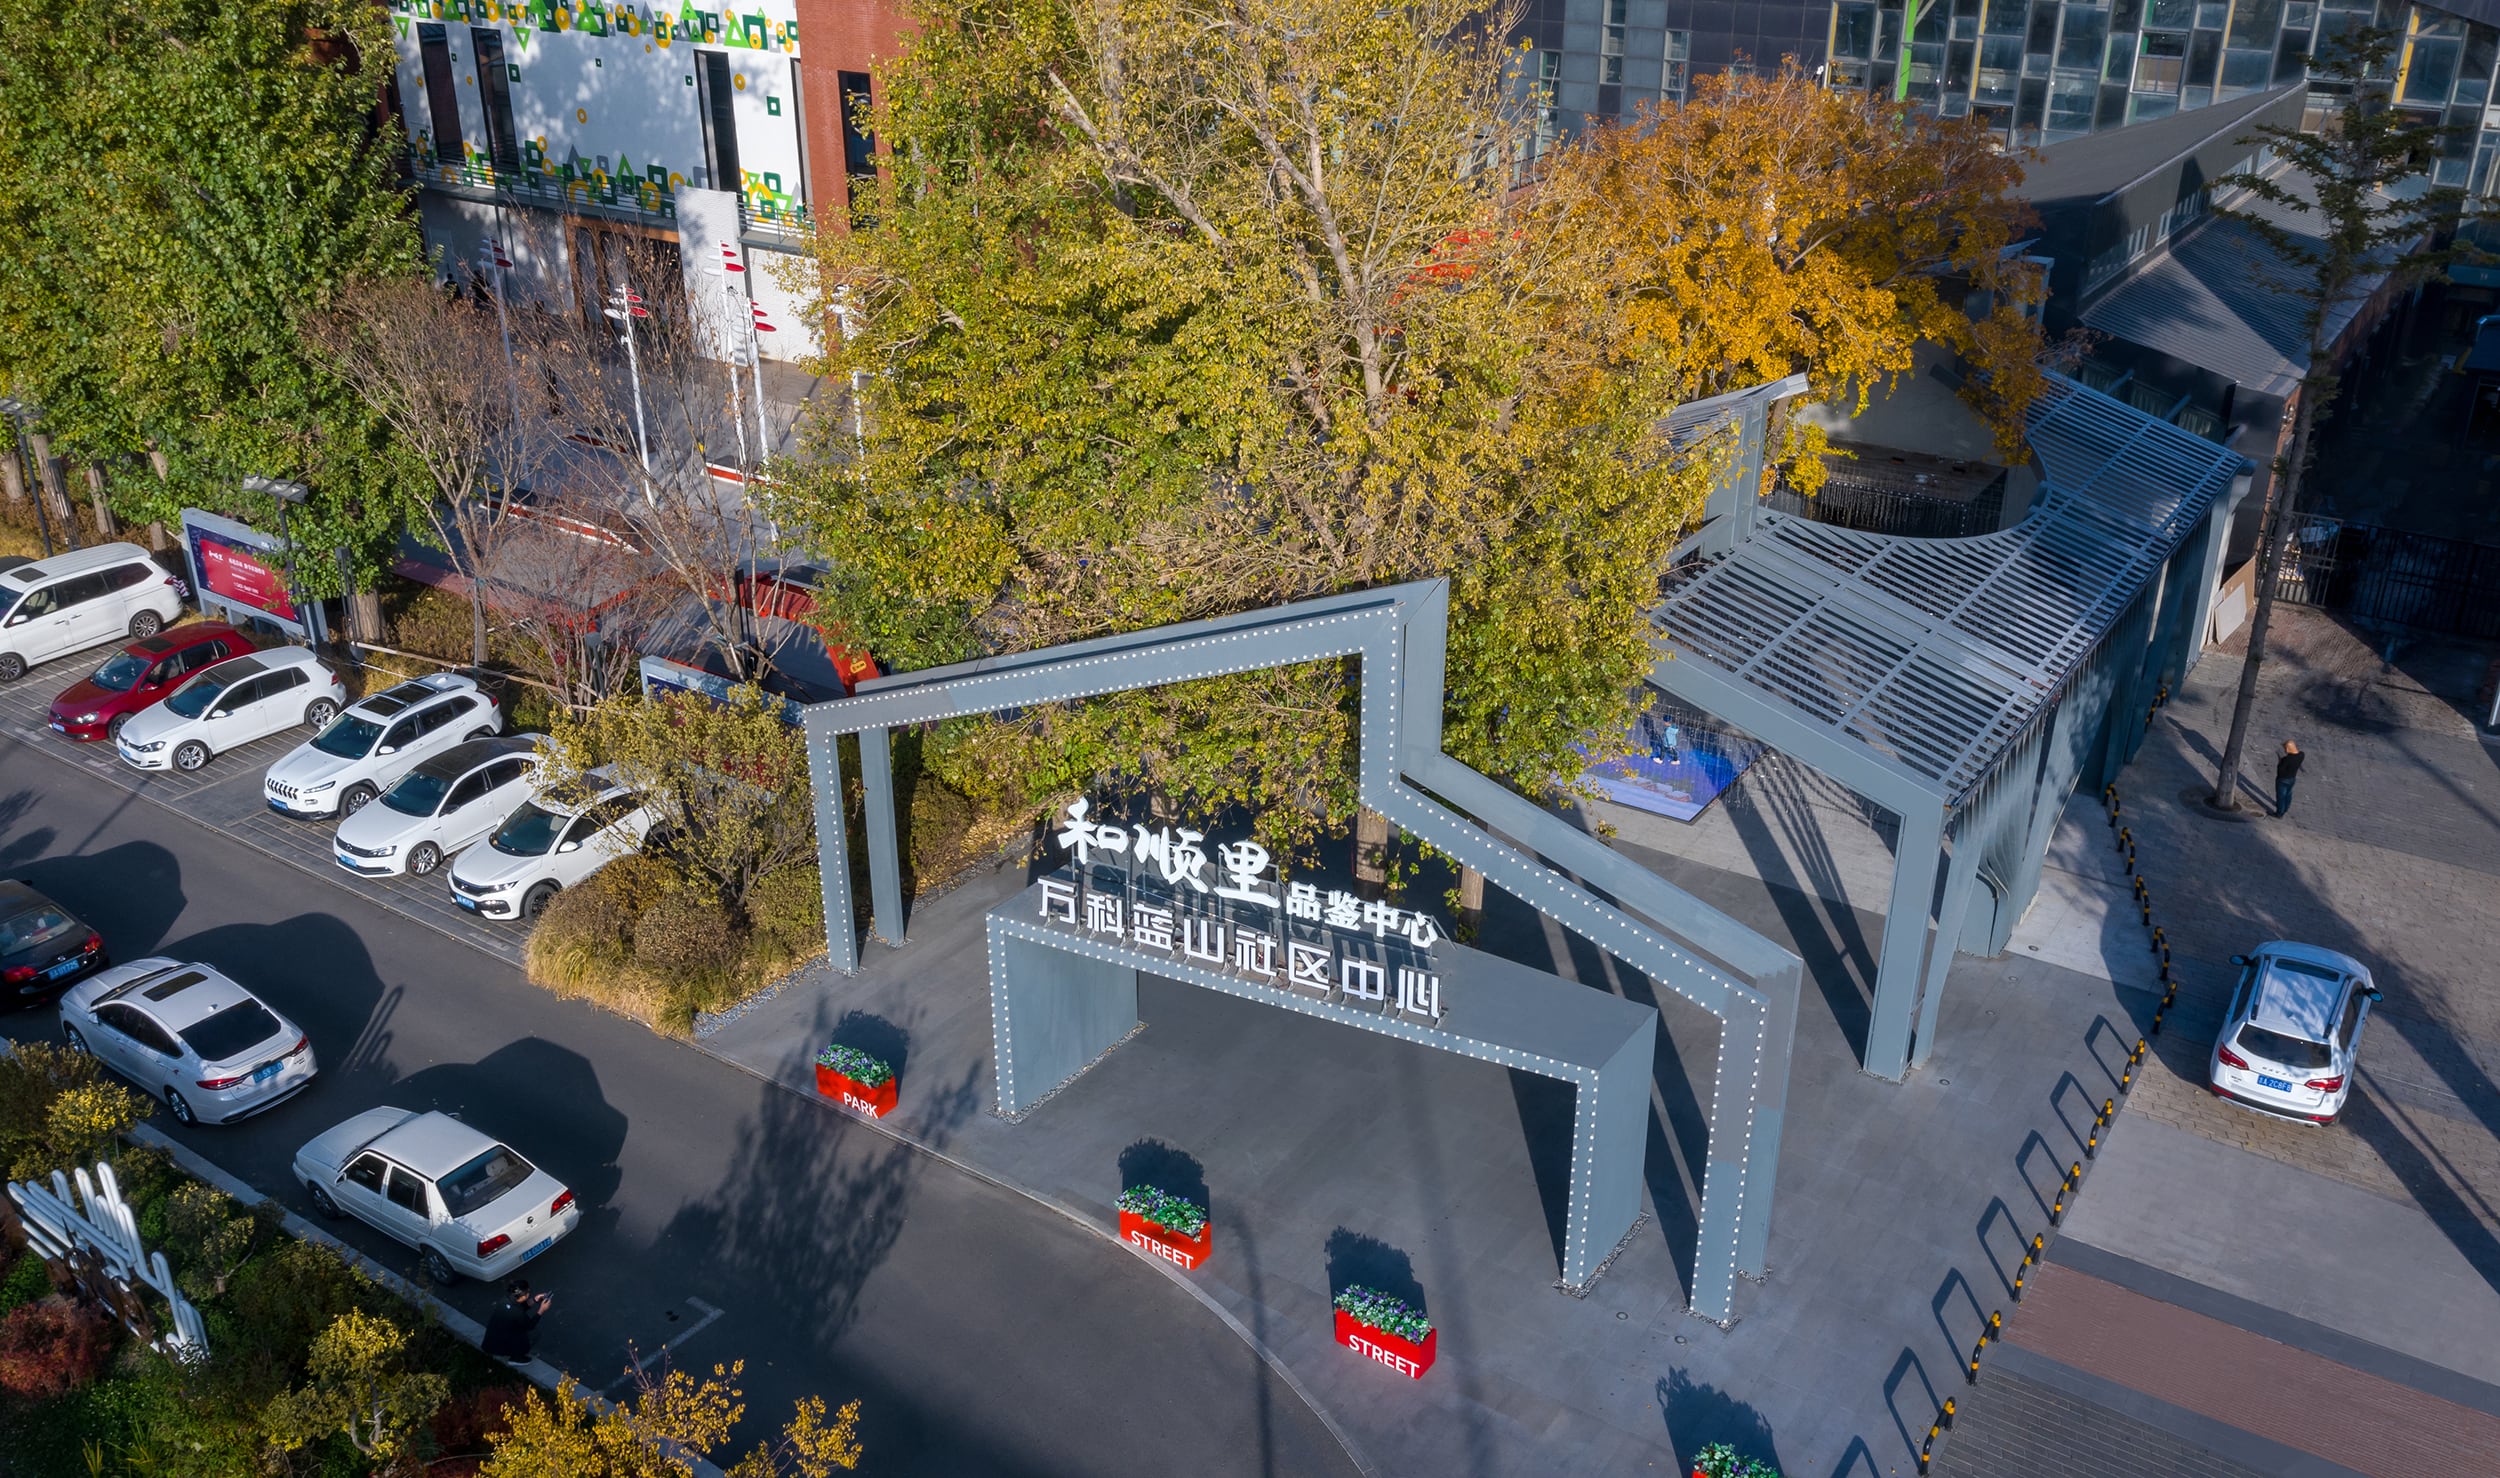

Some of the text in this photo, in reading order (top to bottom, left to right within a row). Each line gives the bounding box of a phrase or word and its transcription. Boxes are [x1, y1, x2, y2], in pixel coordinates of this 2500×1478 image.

[1058, 797, 1438, 949] 和顺里 品鉴中心
[1037, 878, 1442, 1018] 万科蓝山社区中心
[843, 1091, 878, 1119] PARK
[1130, 1230, 1194, 1270] STREET
[1348, 1334, 1420, 1378] STREET
